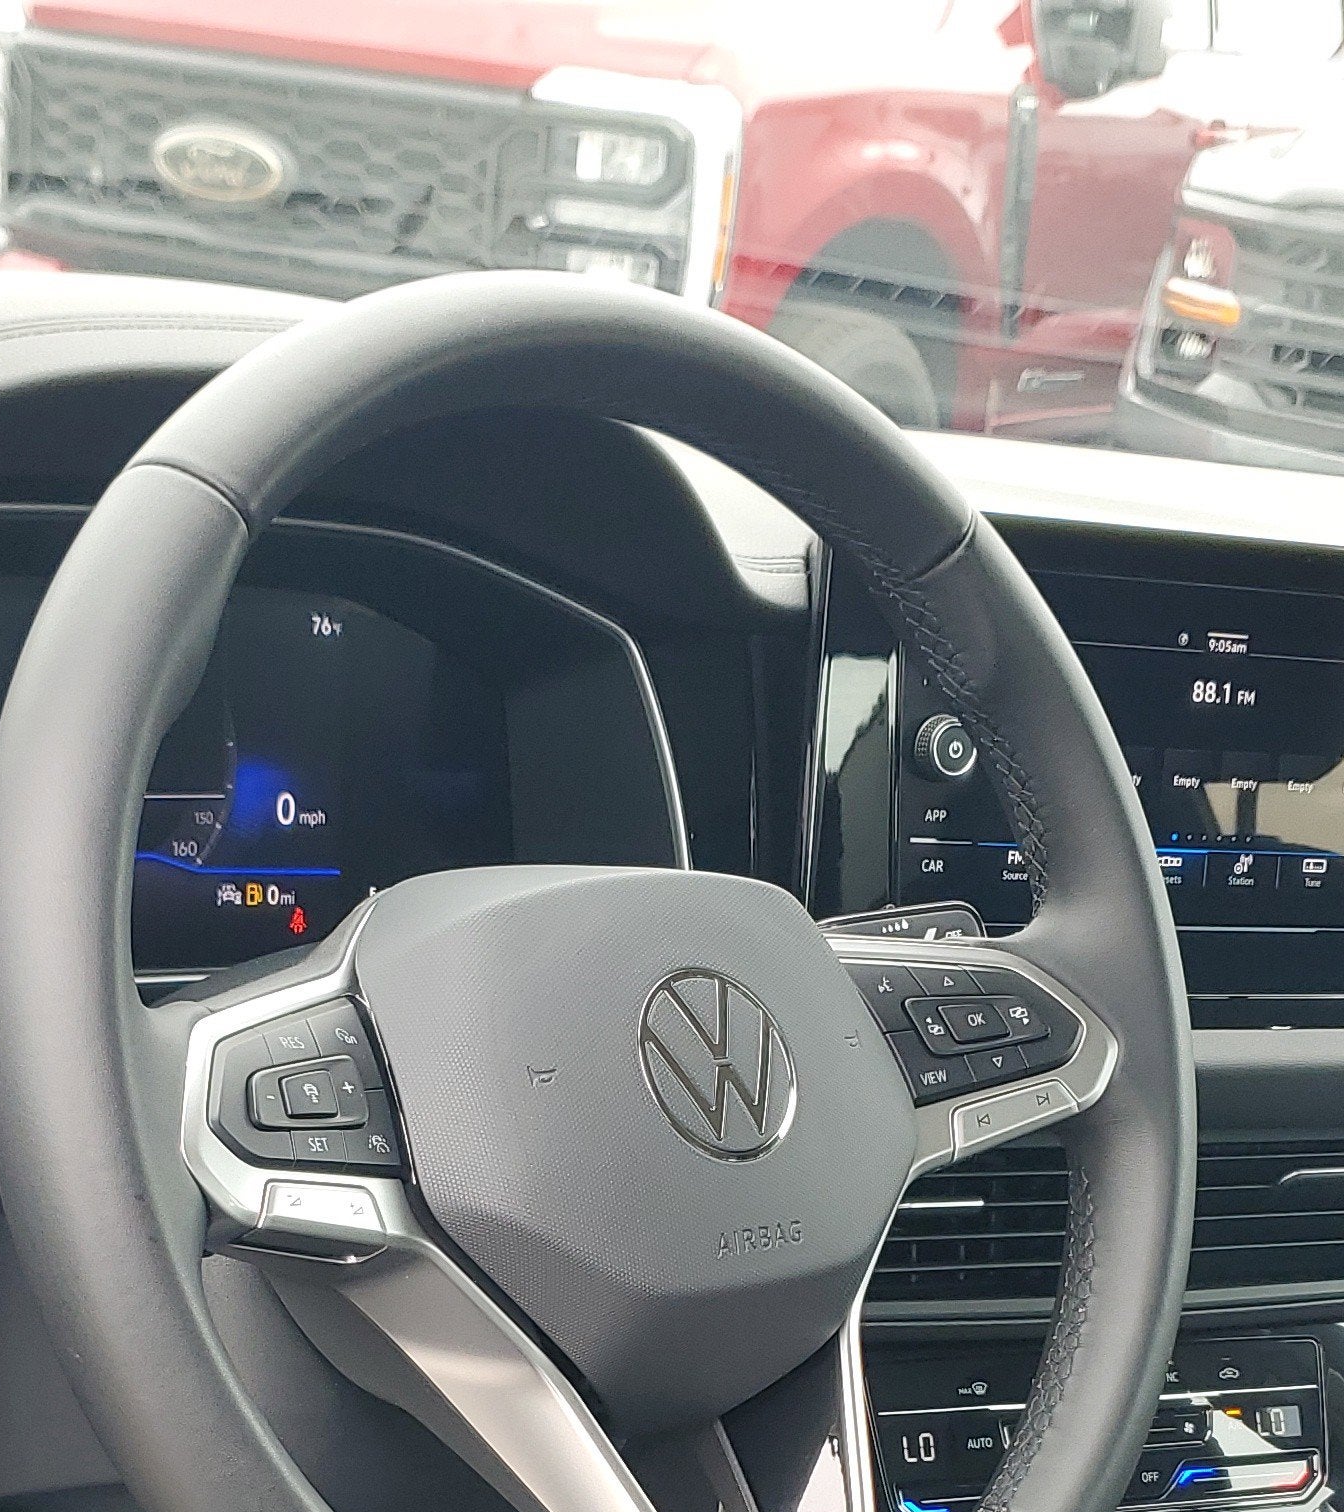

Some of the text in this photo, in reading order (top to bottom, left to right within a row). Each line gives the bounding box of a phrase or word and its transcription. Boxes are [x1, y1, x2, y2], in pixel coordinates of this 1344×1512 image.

[1208, 639, 1248, 655] 9:05am
[1192, 680, 1256, 706] 88.1 FM
[1173, 775, 1201, 788] Empty
[1231, 777, 1258, 791] Empty
[1287, 780, 1314, 794] Empty
[276, 791, 326, 828] 0 mph
[924, 809, 948, 823] APP
[194, 811, 214, 826] 150
[172, 841, 198, 858] 160
[921, 859, 944, 873] CAR
[1001, 870, 1029, 882] Source
[1227, 875, 1255, 887] Station
[267, 884, 296, 905] 0 mi
[967, 1013, 987, 1028] OK
[281, 1036, 305, 1050] RES
[919, 1069, 948, 1086] VIEW
[308, 1138, 330, 1153] SET
[716, 1220, 803, 1260] AIRBAG
[967, 1437, 993, 1450] AUTO
[1141, 1471, 1160, 1483] OFF
